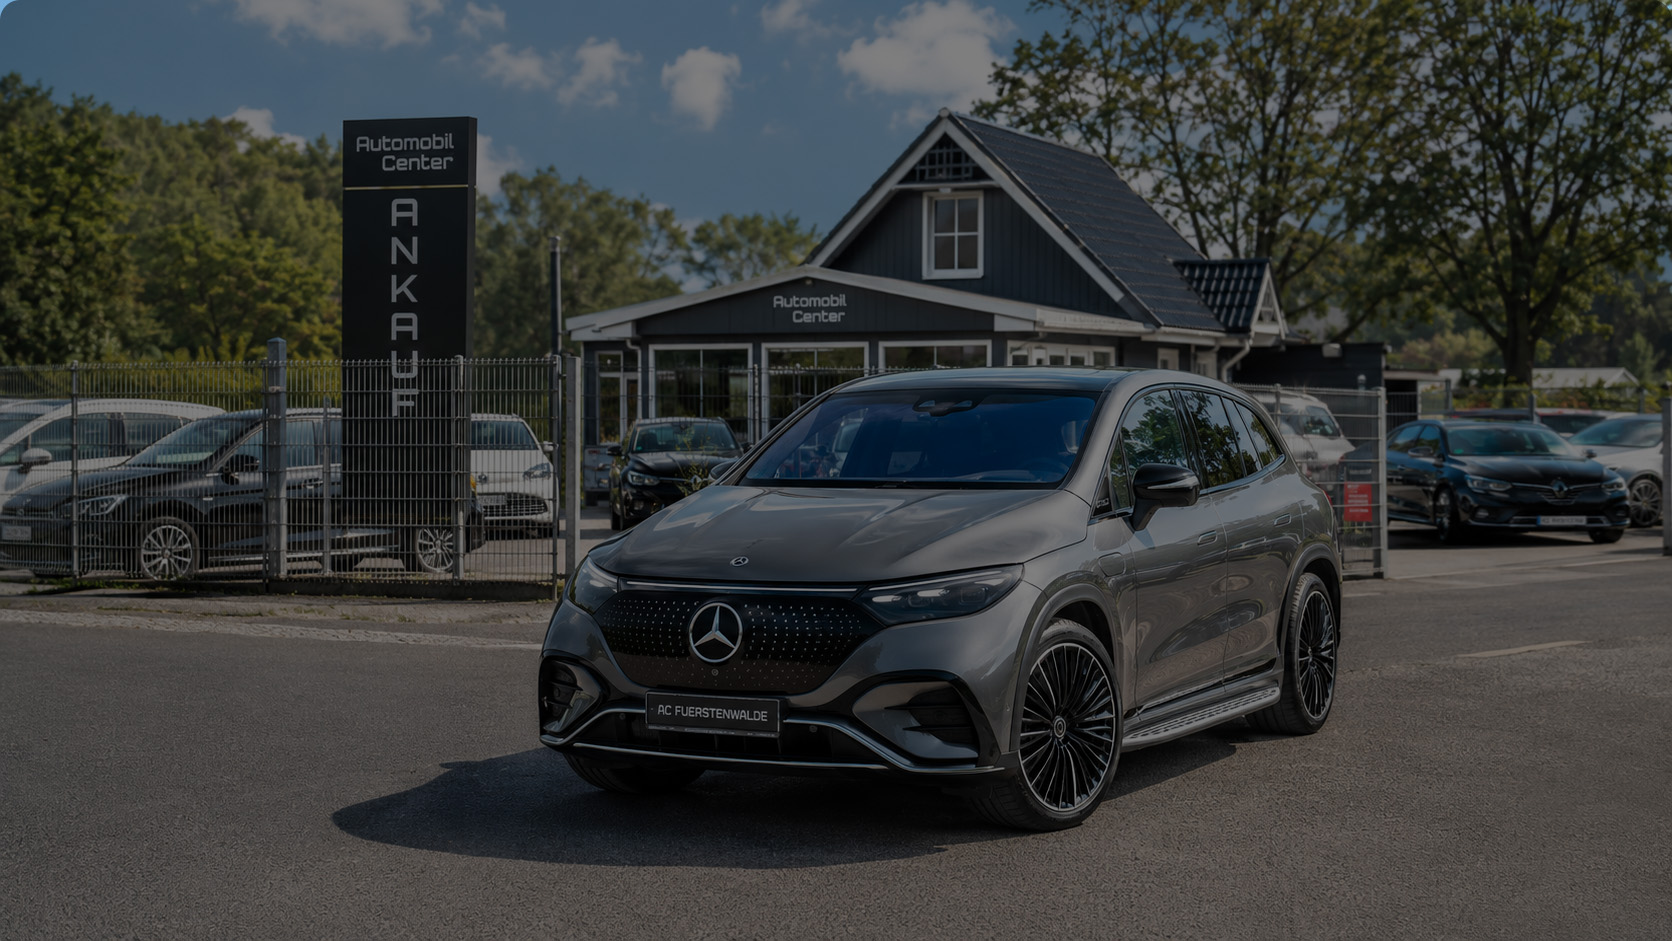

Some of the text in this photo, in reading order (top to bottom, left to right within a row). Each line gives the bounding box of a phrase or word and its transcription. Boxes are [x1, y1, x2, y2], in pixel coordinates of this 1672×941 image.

[356, 133, 454, 152] Automobil
[382, 154, 453, 171] Center
[391, 198, 418, 416] ANKAUF
[773, 294, 847, 308] Automobil
[792, 310, 845, 323] Center
[657, 704, 768, 721] AC FUERSTENWALDE
